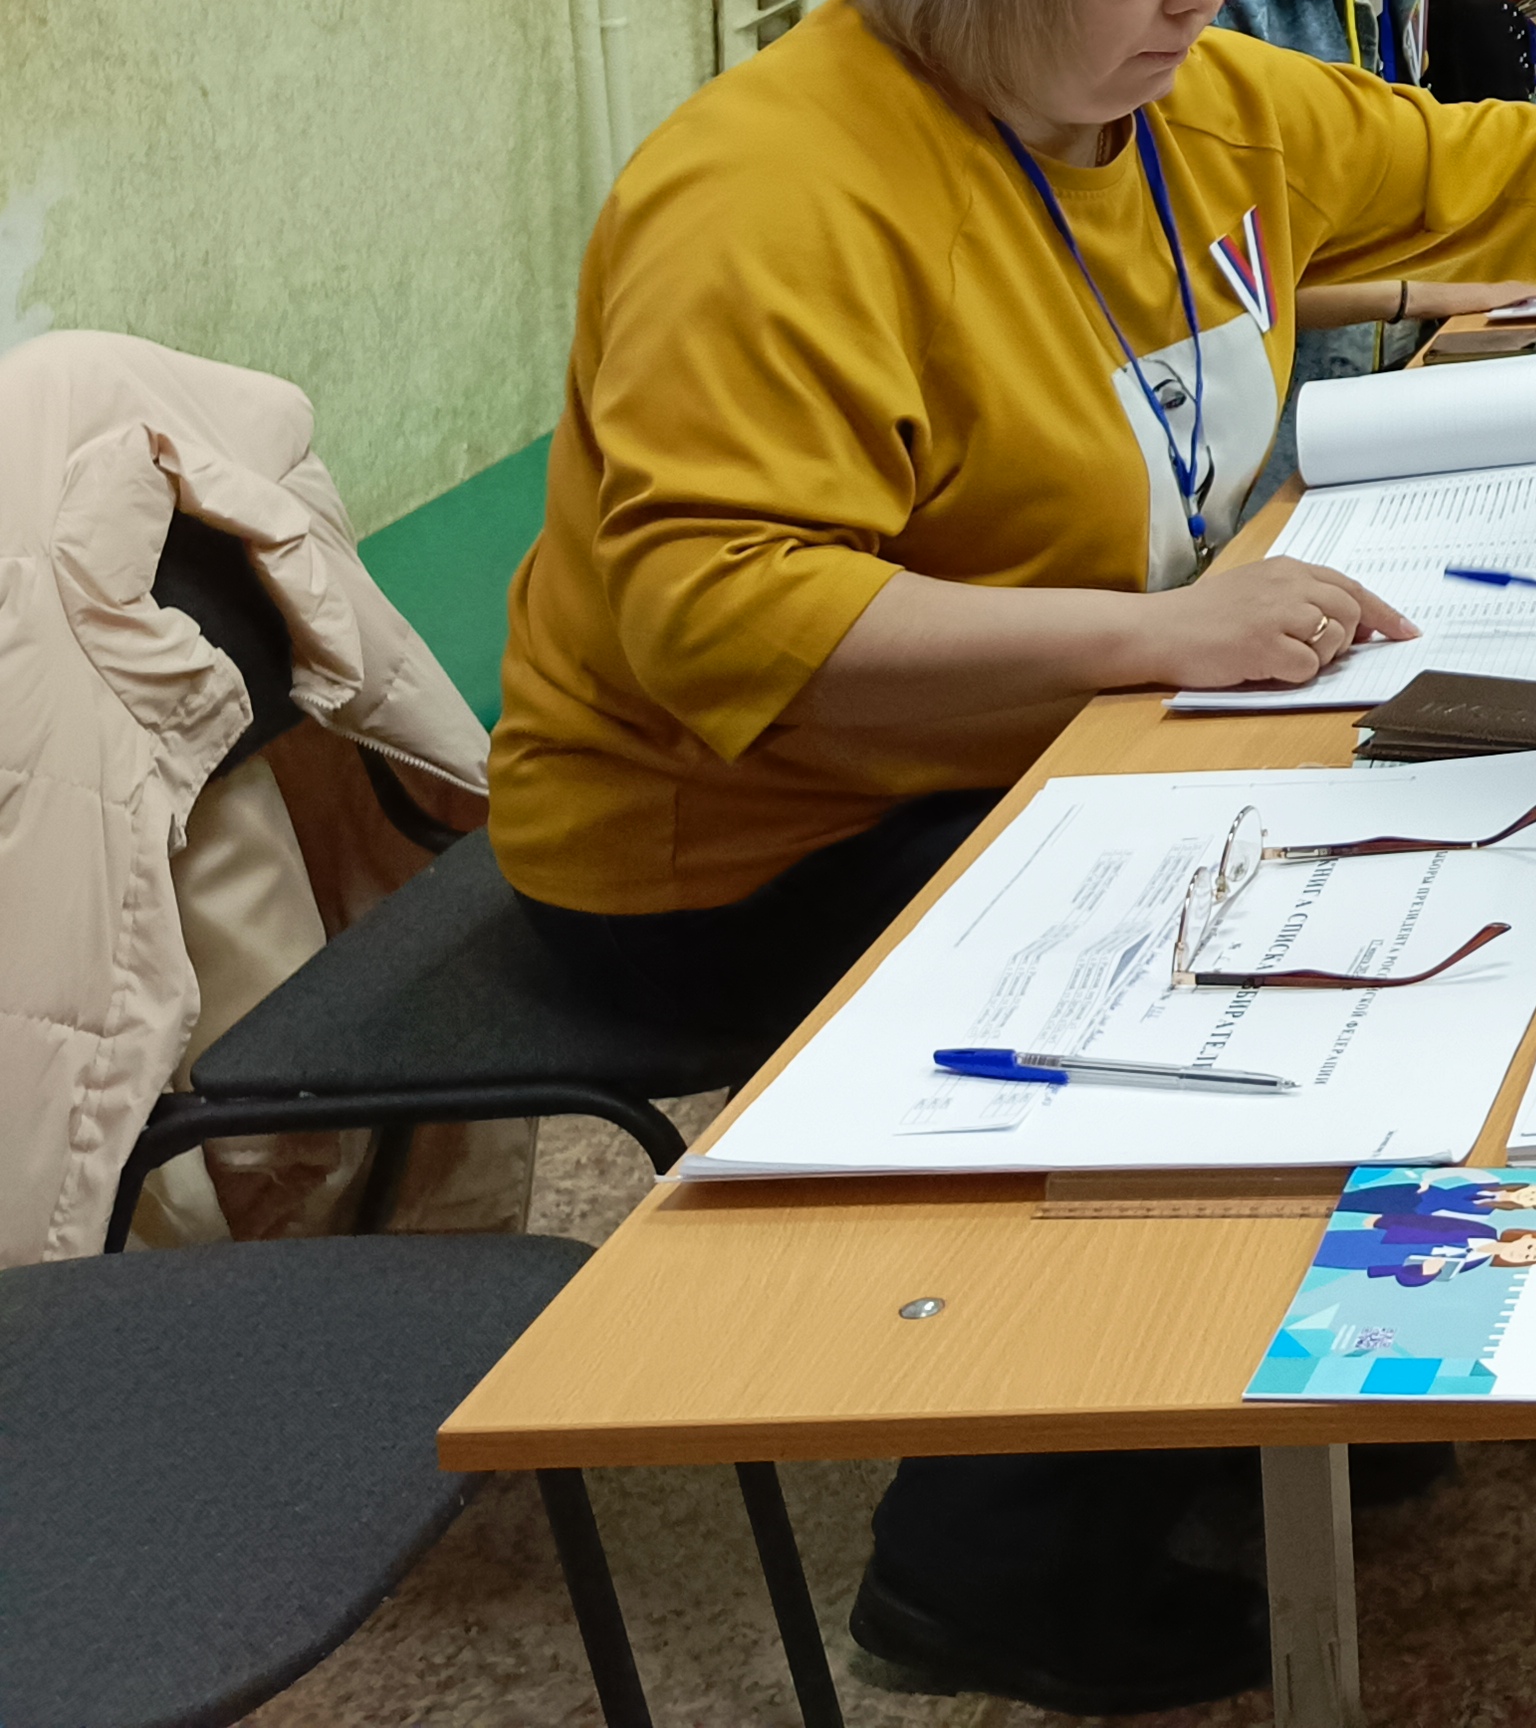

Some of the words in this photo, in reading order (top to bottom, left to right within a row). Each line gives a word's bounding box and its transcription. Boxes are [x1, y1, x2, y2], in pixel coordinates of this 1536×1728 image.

[1295, 857, 1339, 908] КНИГА
[1421, 850, 1449, 885] ЫБОРЫ
[1256, 912, 1309, 971] СПИСКА
[1388, 886, 1432, 954] ПРЕЗИДЕНТА
[1314, 1020, 1359, 1085] ФЕДЕРАЦИИ
